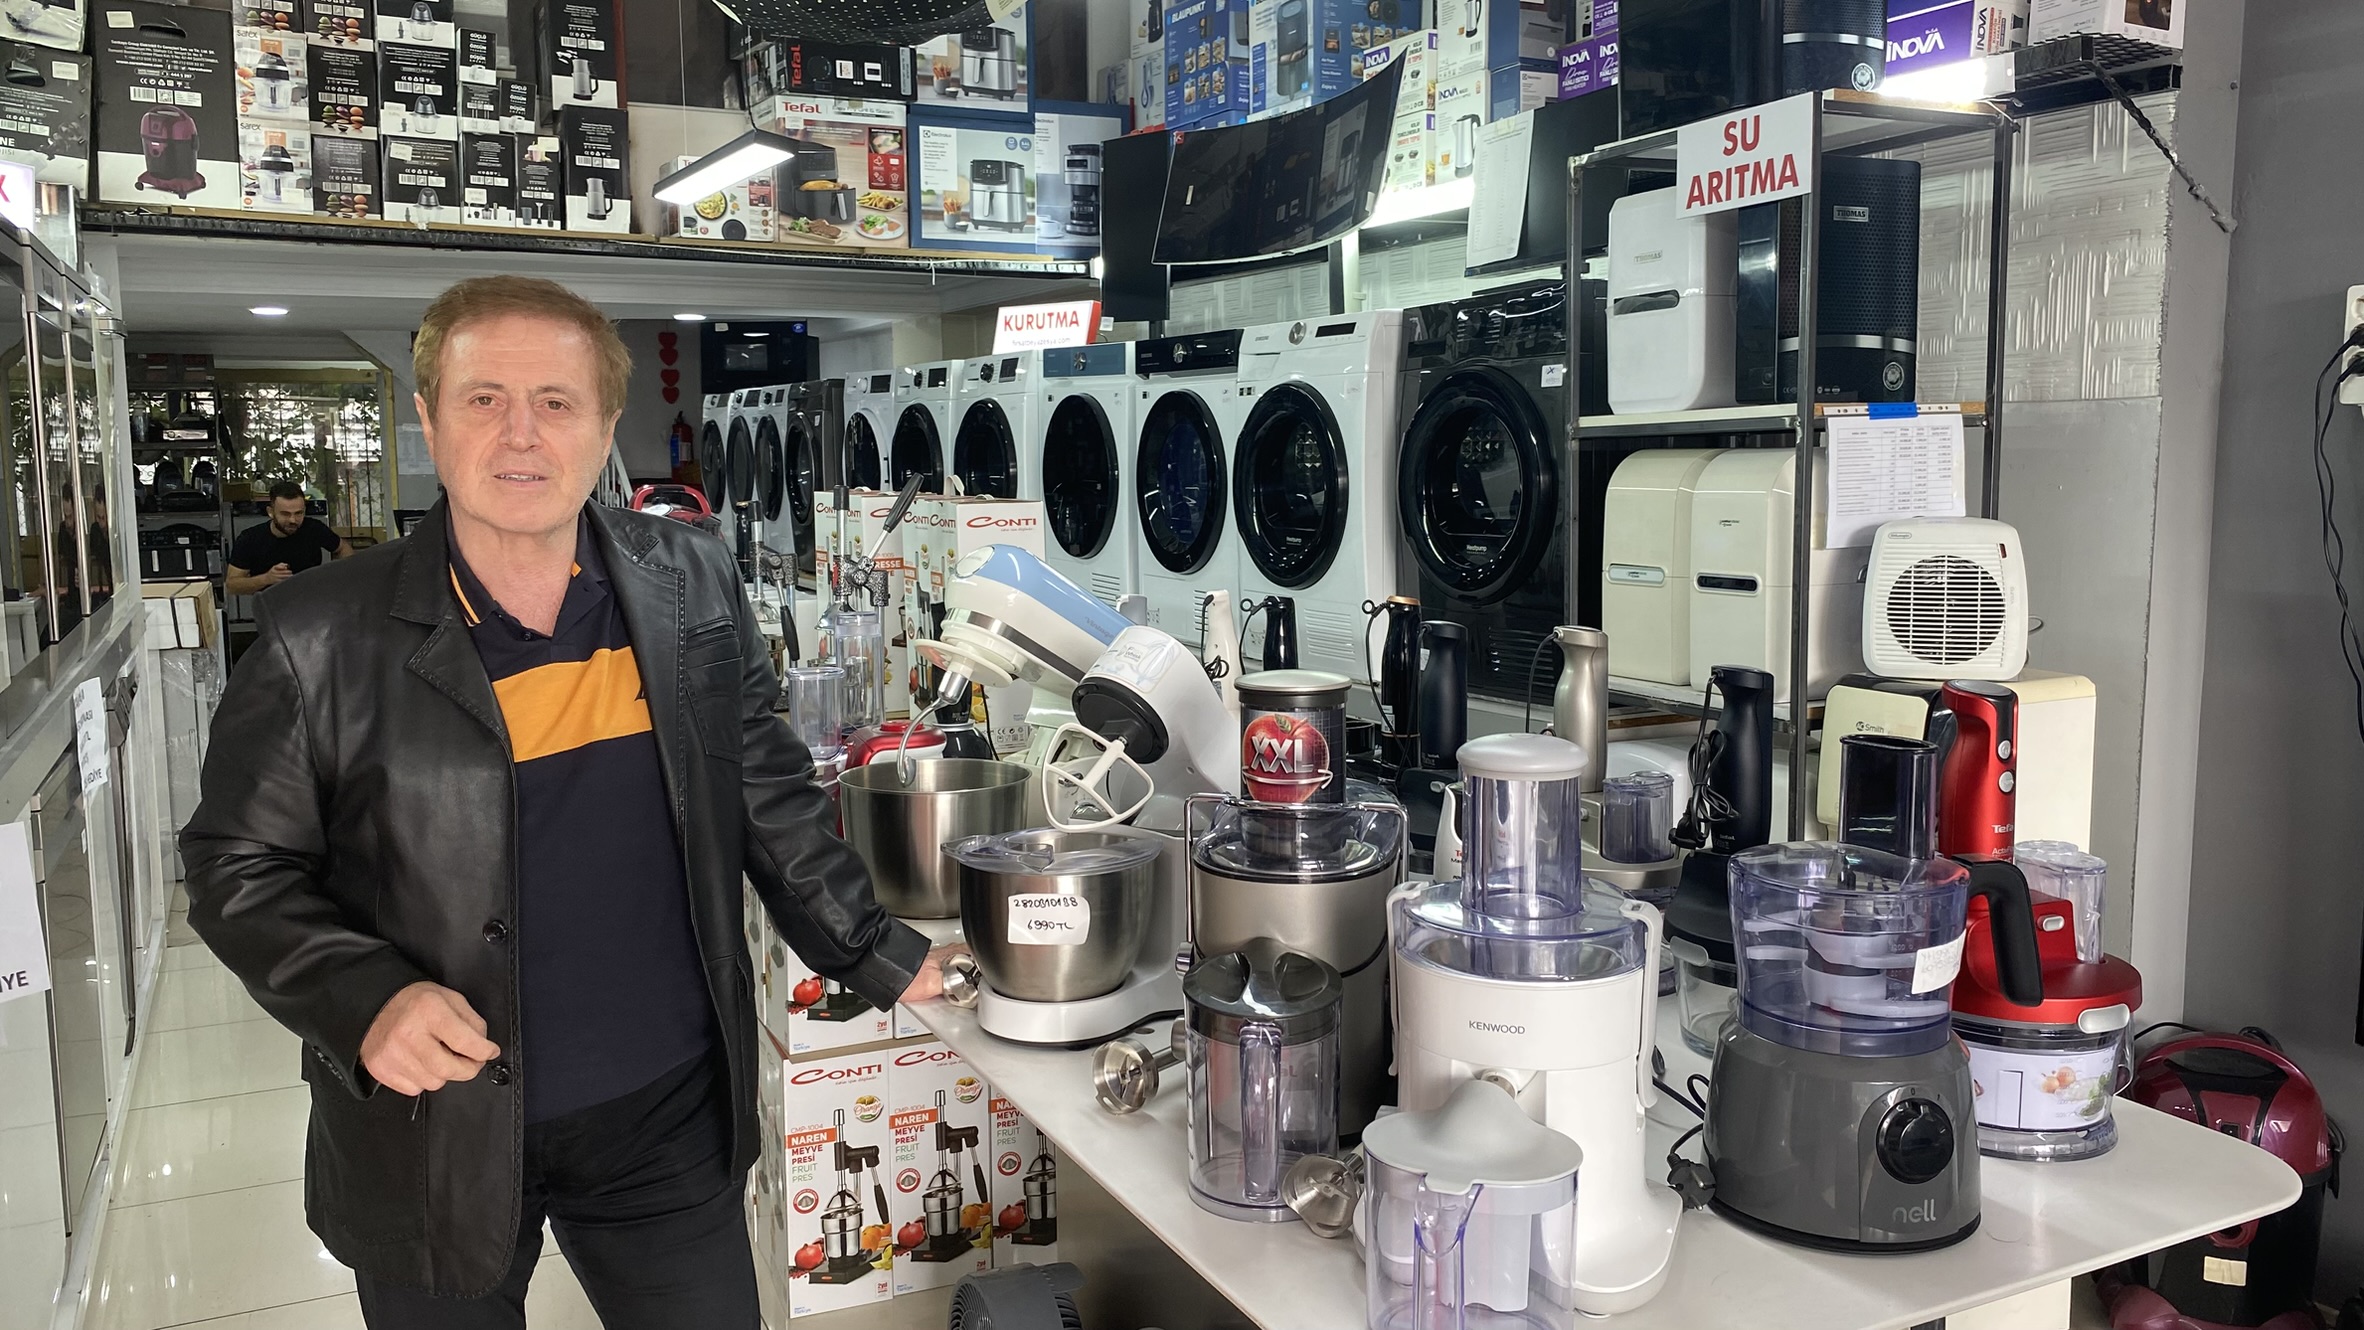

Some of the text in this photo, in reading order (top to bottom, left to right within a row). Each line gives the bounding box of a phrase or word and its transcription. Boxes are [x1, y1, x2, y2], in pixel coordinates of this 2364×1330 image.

[237, 29, 258, 38] sarex
[1976, 7, 1988, 50] INOVA
[791, 44, 802, 87] Tefal
[1562, 51, 1590, 68] INOVA
[782, 101, 822, 114] Tefal
[240, 122, 261, 131] sarex
[1722, 114, 1761, 157] SU
[1685, 153, 1800, 211] ARITMA
[1836, 209, 1866, 218] THOMAS
[1004, 310, 1080, 332] KURUTMA
[903, 511, 929, 523] CONTI
[930, 514, 956, 529] CONTI
[966, 516, 1037, 528] CONTI
[1865, 723, 1885, 734] Smith
[1250, 736, 1314, 774] XXL
[1468, 1020, 1525, 1035] KENWOOD
[791, 1064, 882, 1085] CONTI
[854, 1101, 881, 1116] Orange
[894, 1104, 925, 1114] CMP-1004
[894, 1112, 929, 1126] NAREN
[997, 1119, 1019, 1129] PRESİ
[791, 1123, 824, 1134] CMP-1004
[895, 1125, 925, 1137] MEYVE
[997, 1127, 1021, 1138] FRUIT
[791, 1132, 828, 1146] NAREN
[895, 1134, 918, 1145] PRESİ
[997, 1136, 1017, 1146] PRES
[792, 1144, 823, 1156] MEYVE
[895, 1142, 920, 1154] FRUIT
[792, 1154, 815, 1166] PRESİ
[895, 1153, 916, 1163] PRES
[792, 1163, 818, 1175] FRUIT
[792, 1173, 813, 1184] PRES
[1893, 1198, 1937, 1224] nell
